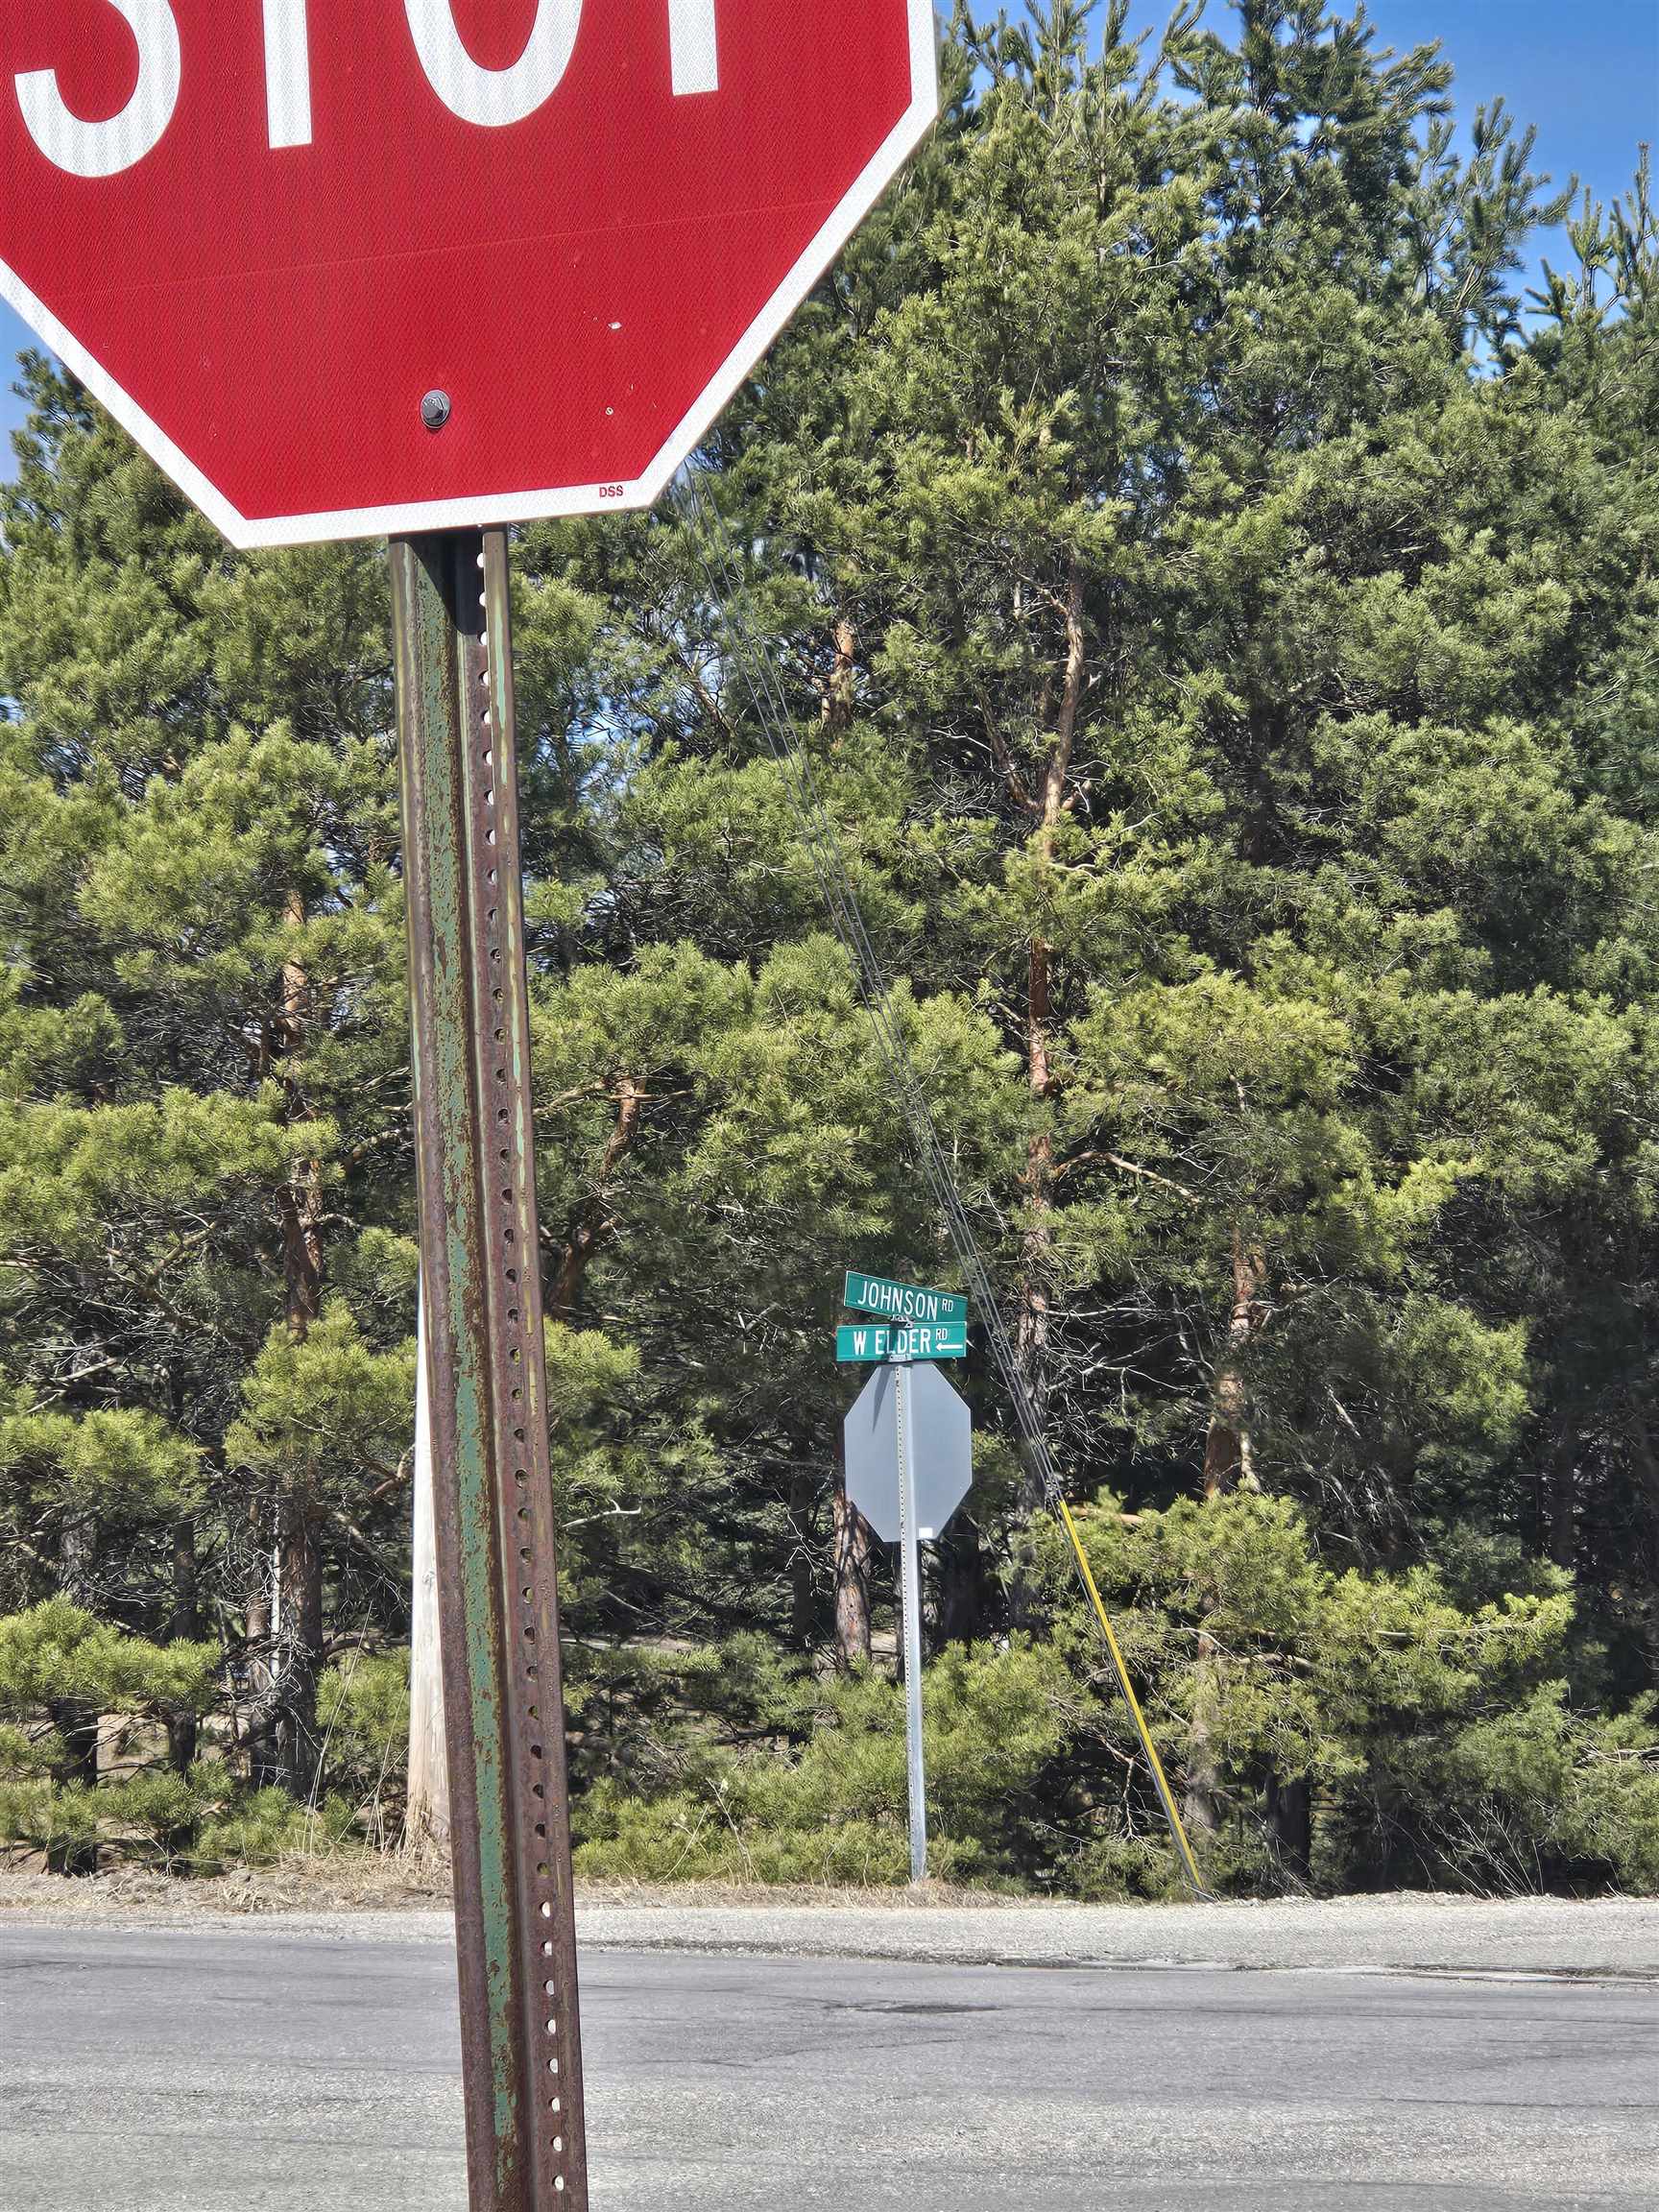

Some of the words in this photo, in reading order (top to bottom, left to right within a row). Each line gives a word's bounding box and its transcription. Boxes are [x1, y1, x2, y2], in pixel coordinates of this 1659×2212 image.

[599, 485, 623, 497] DSS
[857, 1281, 938, 1321] JOHNSON
[942, 1299, 953, 1311] RD
[854, 1331, 866, 1356] W
[875, 1329, 931, 1355] ELDER
[935, 1328, 948, 1340] RD
